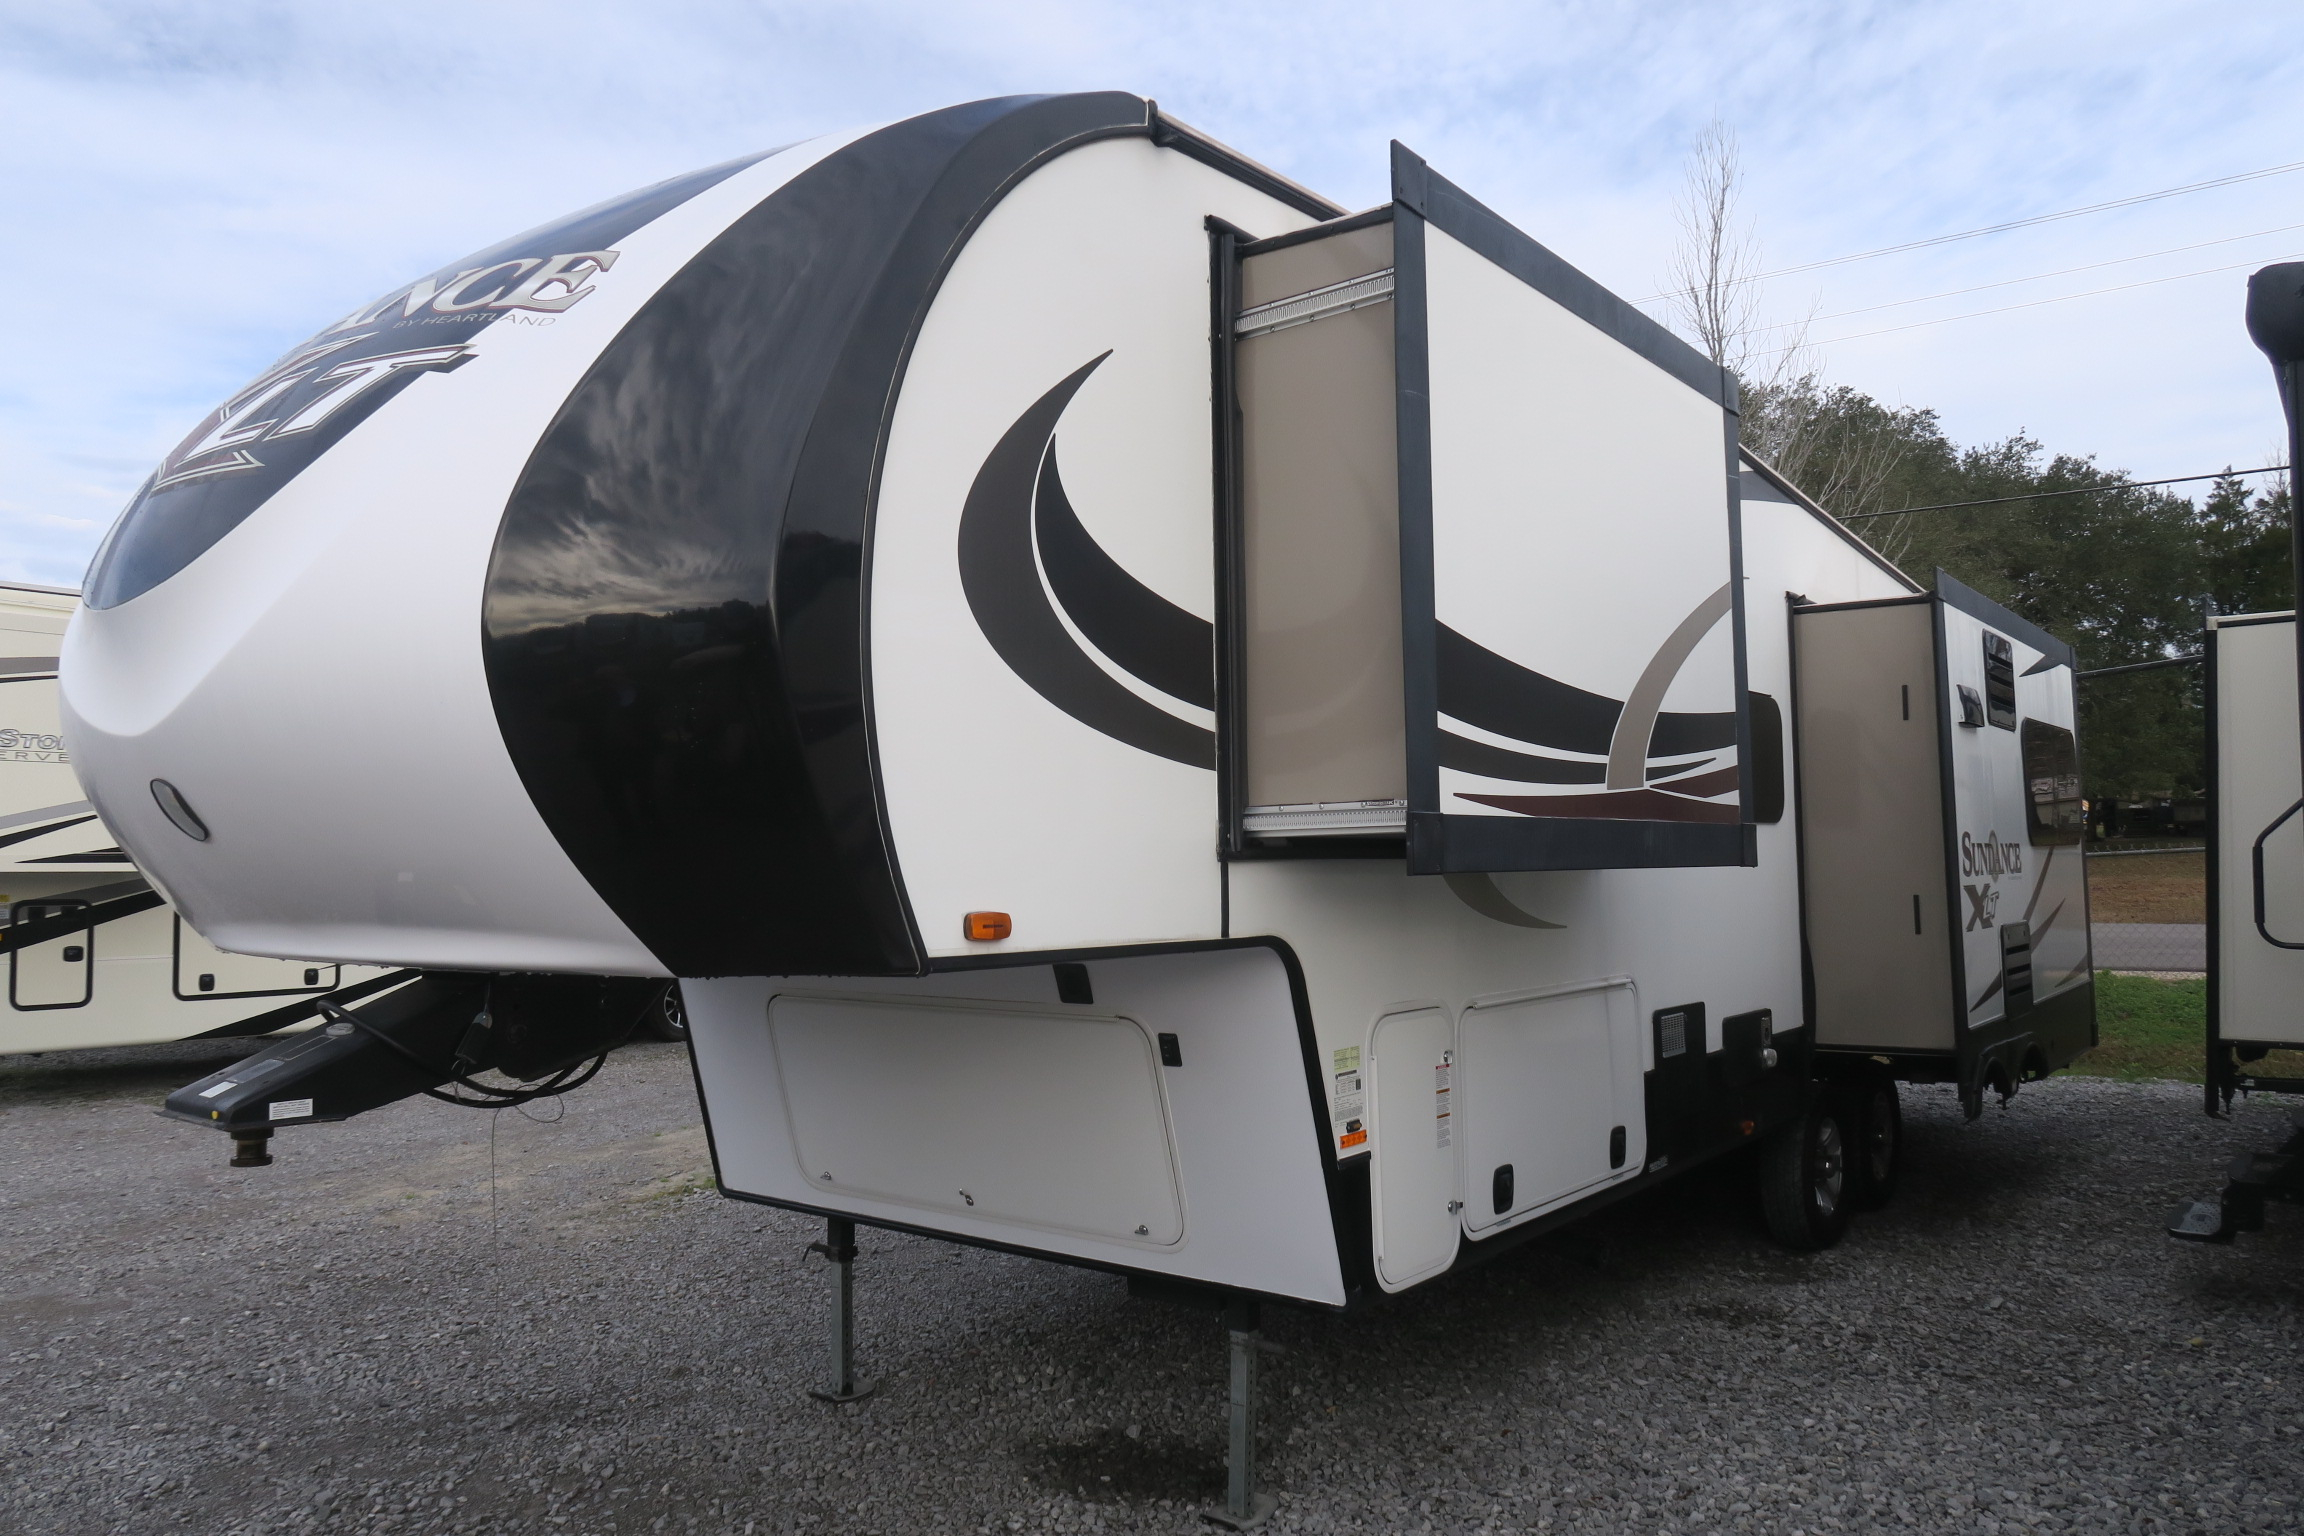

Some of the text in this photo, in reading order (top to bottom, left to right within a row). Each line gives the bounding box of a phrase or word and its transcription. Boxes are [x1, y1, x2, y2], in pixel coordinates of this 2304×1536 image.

[320, 250, 621, 336] ANCE
[392, 312, 557, 330] BY HEARTLAND
[1962, 830, 2022, 878] SUNDANCE
[1963, 883, 2000, 933] XLT
